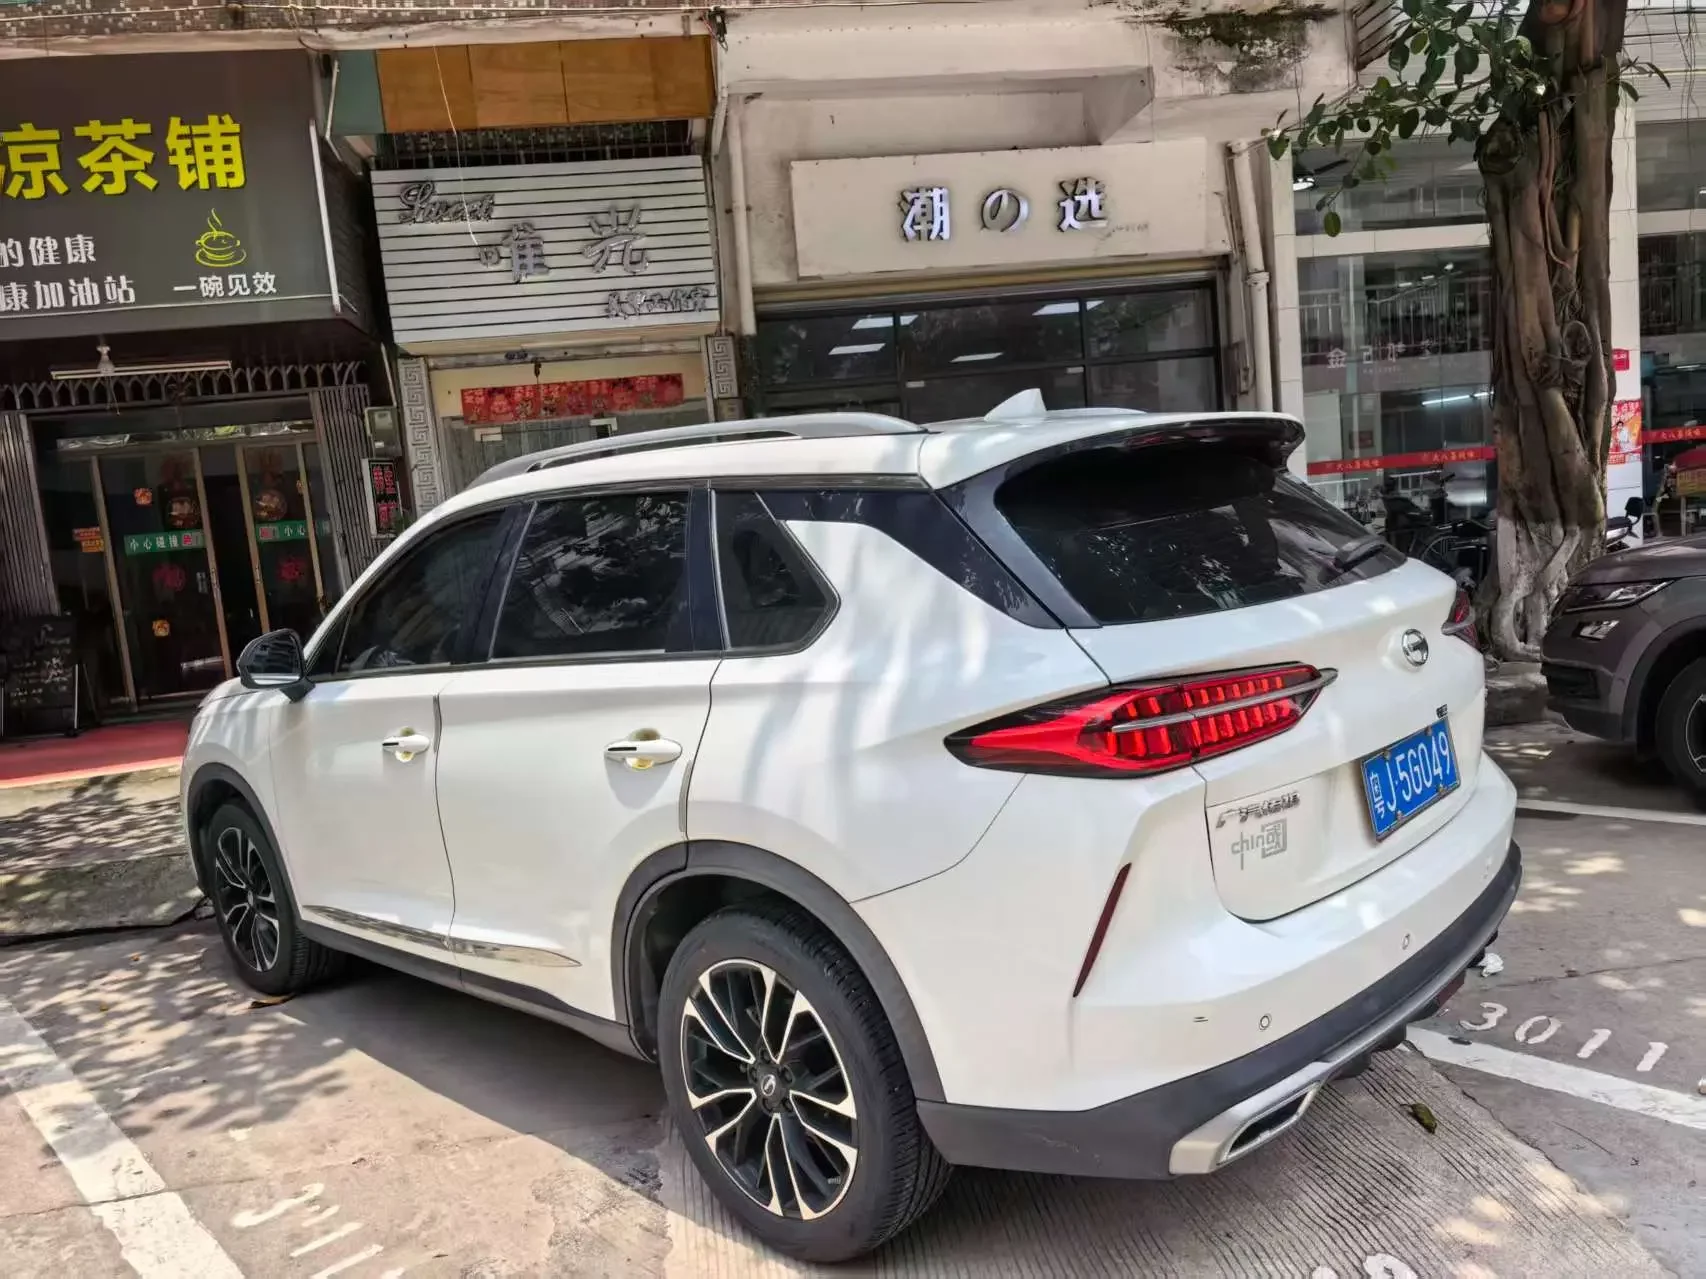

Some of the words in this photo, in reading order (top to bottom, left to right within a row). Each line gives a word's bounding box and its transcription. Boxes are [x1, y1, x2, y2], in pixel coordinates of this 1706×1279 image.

[0, 113, 248, 201] 凉茶铺
[896, 176, 1110, 243] 潮の选
[0, 234, 97, 268] 的健康
[0, 274, 137, 312] 康加油站
[172, 271, 278, 299] 一碗见效
[129, 533, 180, 554] 小心碰撞
[1458, 1001, 1669, 1073] 3011
